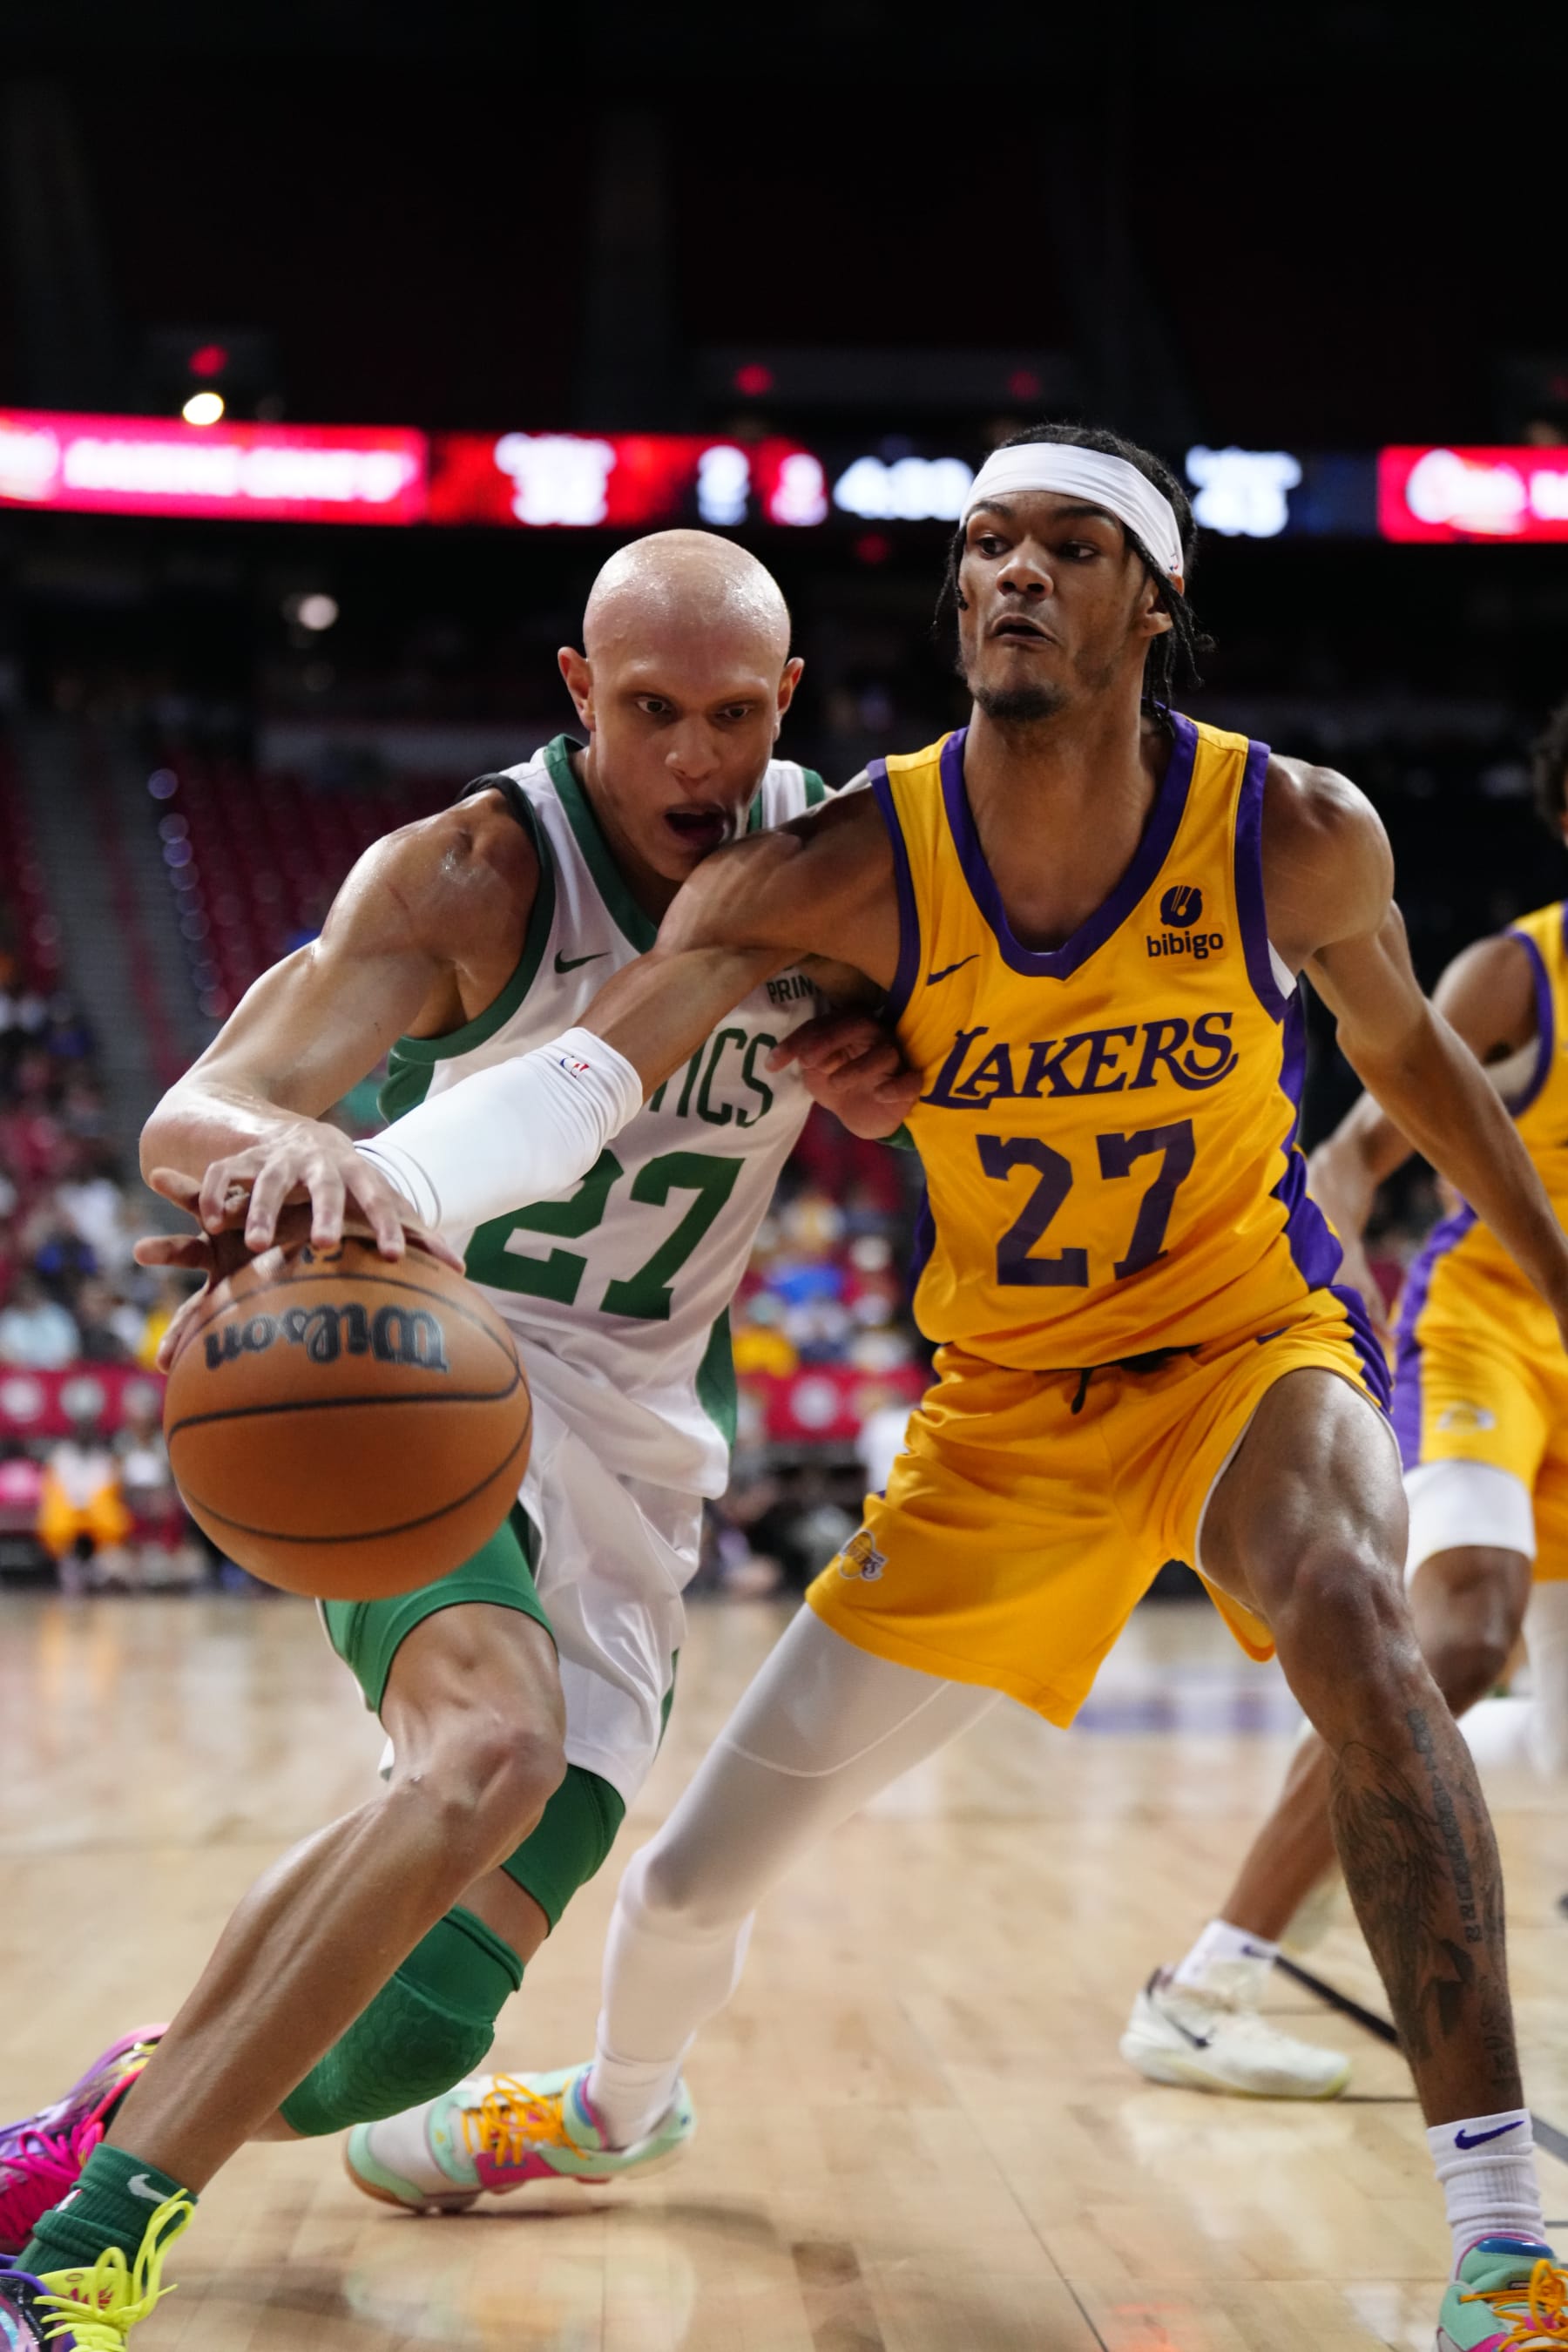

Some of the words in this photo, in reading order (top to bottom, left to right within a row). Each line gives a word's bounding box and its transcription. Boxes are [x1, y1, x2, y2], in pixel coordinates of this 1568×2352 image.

[1146, 930, 1224, 960] bibigo
[918, 1011, 1239, 1110] LAKERS
[463, 1148, 747, 1321] 27
[976, 1119, 1196, 1288] 27
[204, 1303, 449, 1372] Wilson
